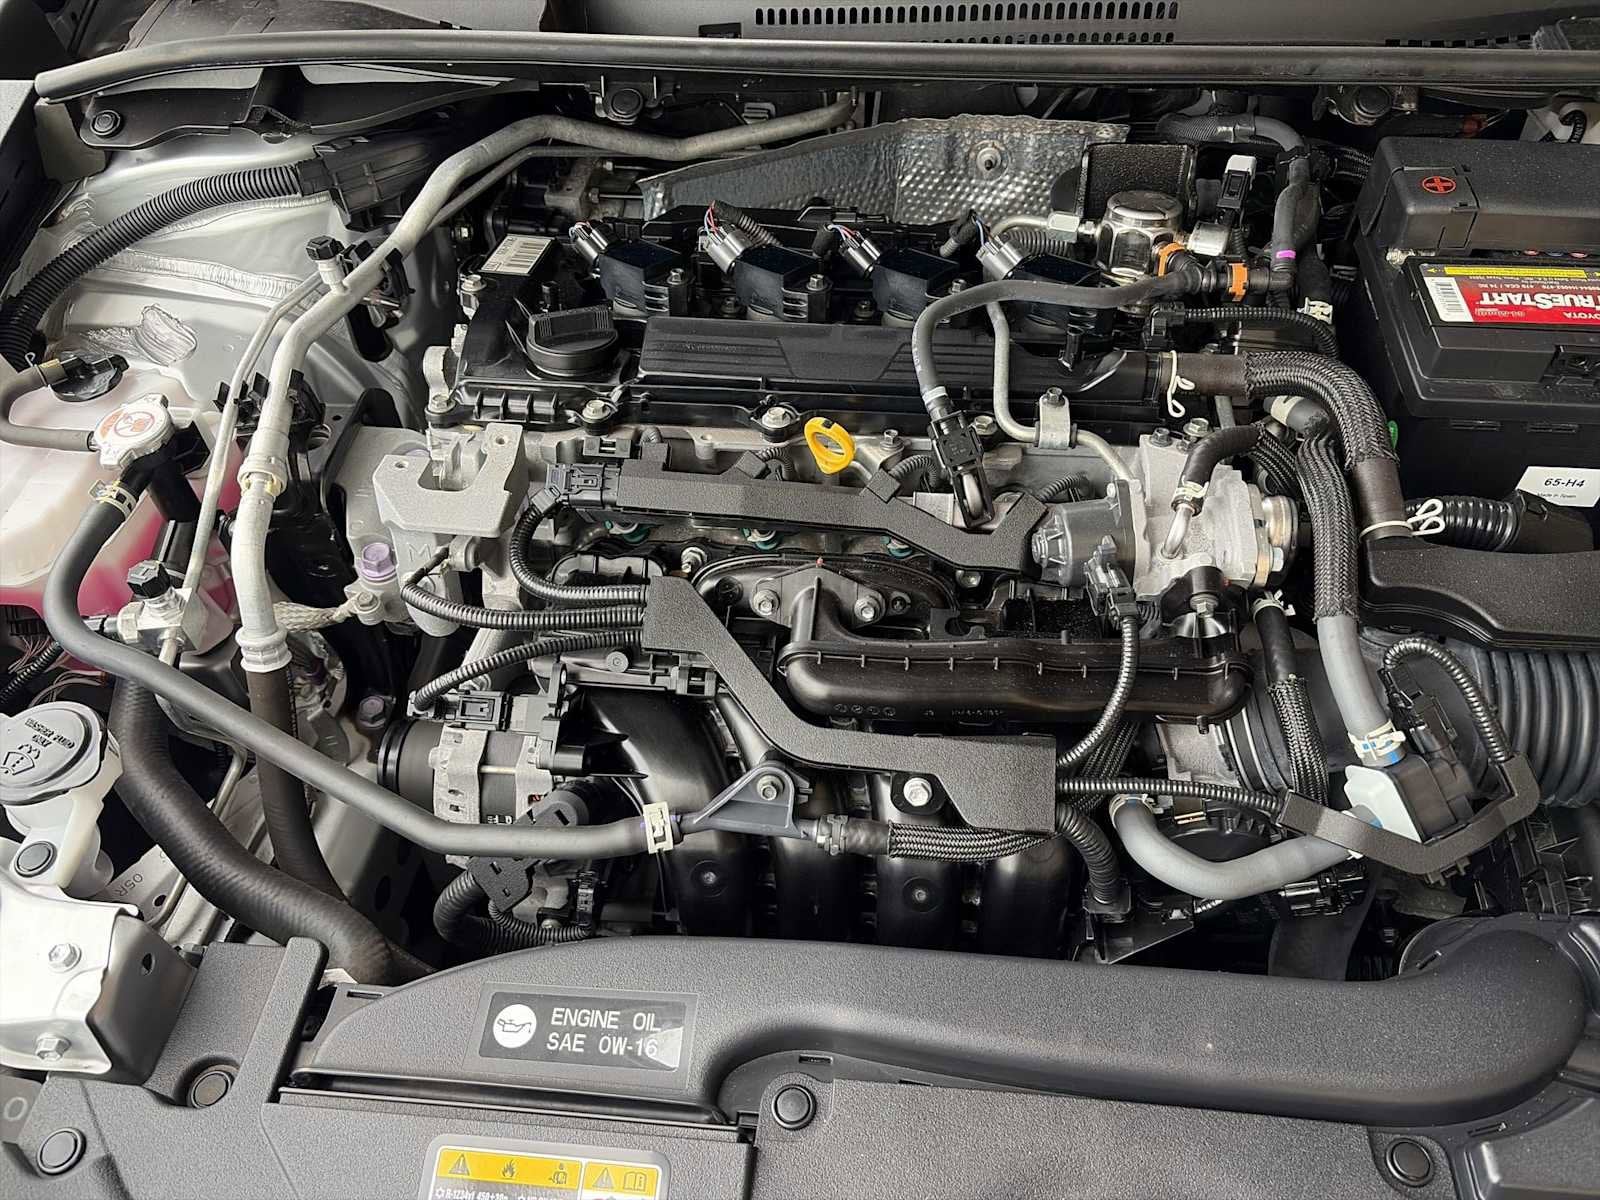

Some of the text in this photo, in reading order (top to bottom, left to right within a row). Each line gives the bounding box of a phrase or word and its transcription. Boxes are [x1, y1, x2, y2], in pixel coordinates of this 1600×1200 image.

[1544, 478, 1586, 488] 65-H4
[551, 1007, 662, 1032] ENGINE OIL
[546, 1032, 658, 1057] SAE 0W-16
